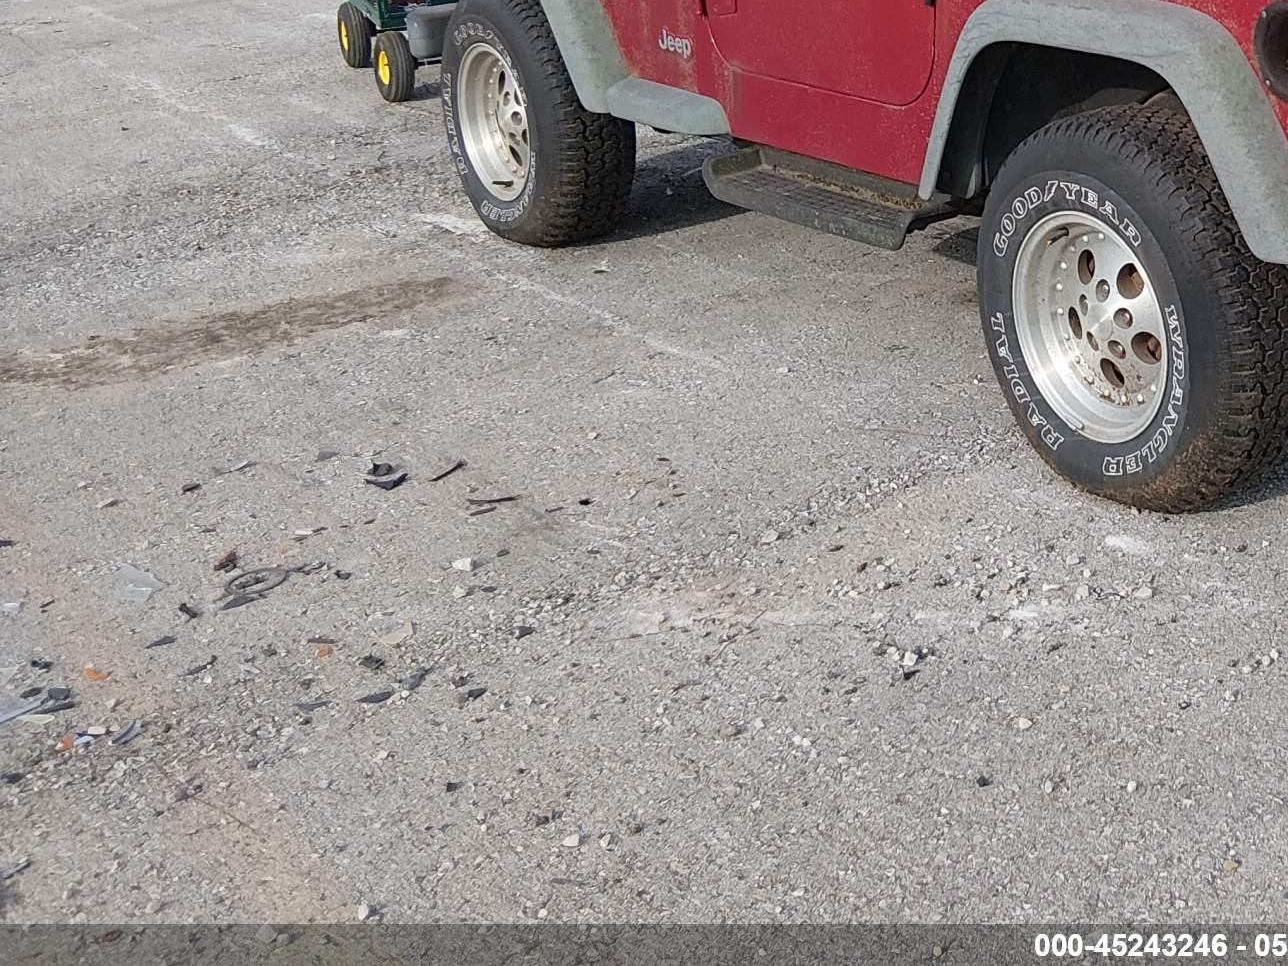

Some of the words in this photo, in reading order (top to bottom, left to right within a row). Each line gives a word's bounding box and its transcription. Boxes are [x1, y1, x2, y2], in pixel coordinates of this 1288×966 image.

[658, 27, 692, 60] Jeep
[990, 311, 1065, 451] RADIAL
[1102, 304, 1186, 476] WRANGLER
